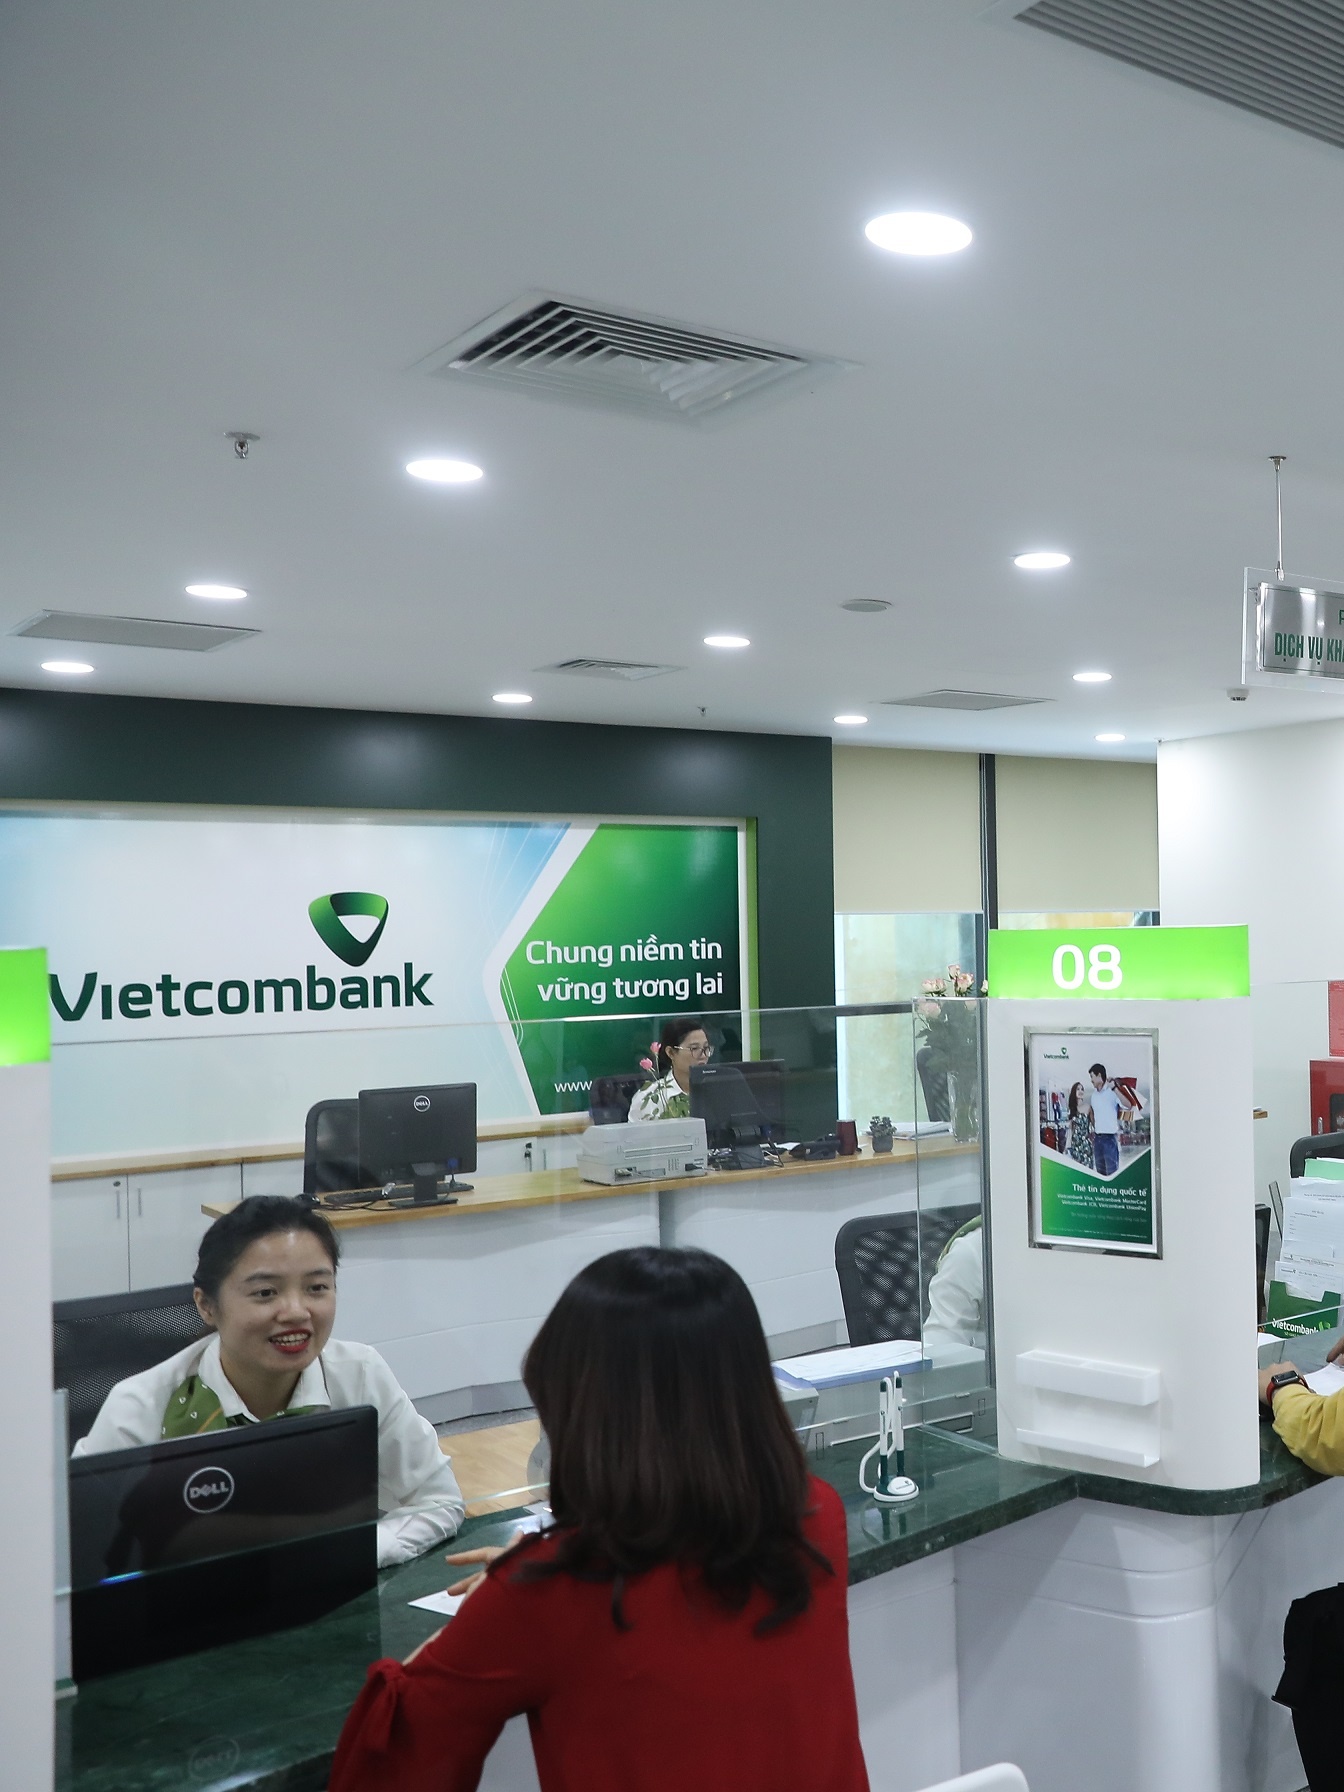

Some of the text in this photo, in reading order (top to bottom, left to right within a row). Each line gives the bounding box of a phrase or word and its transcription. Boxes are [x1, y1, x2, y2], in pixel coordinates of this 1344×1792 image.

[1274, 632, 1303, 662] DỊCH
[1307, 636, 1323, 665] VỤ
[526, 934, 722, 968] Chung niềm tin
[1052, 944, 1123, 990] 08
[48, 962, 434, 1022] Vietcombank
[537, 972, 723, 1004] vững tương lai
[1072, 1183, 1086, 1192] Thẻ
[1100, 1186, 1117, 1196] dụng
[1119, 1187, 1137, 1196] quốc
[1138, 1187, 1147, 1197] tế
[190, 1481, 229, 1499] DELL
